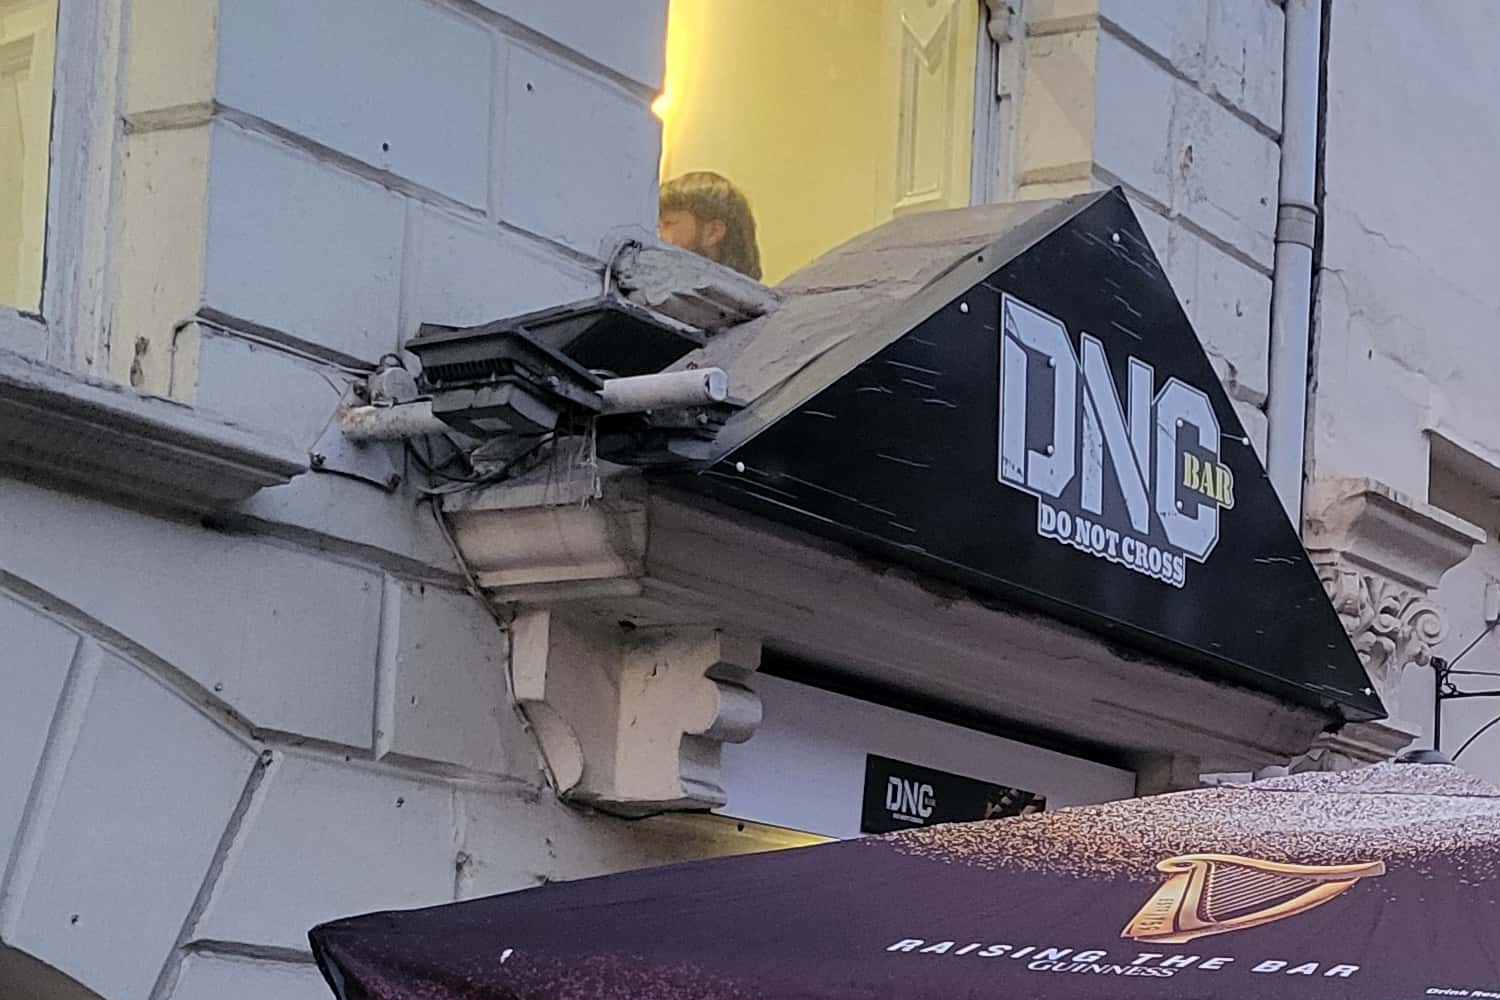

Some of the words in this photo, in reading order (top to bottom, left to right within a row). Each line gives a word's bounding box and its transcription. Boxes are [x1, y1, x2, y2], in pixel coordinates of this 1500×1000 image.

[998, 292, 1222, 564] DNC
[1183, 452, 1234, 506] BAR
[1040, 503, 1073, 540] DO
[1074, 518, 1121, 555] NOT
[1122, 536, 1185, 583] CROSS
[886, 776, 934, 818] DNC
[886, 938, 1108, 965] RAISING
[1132, 952, 1235, 971] THE
[1250, 959, 1361, 978] BAR
[1027, 958, 1180, 978] GUINNESS
